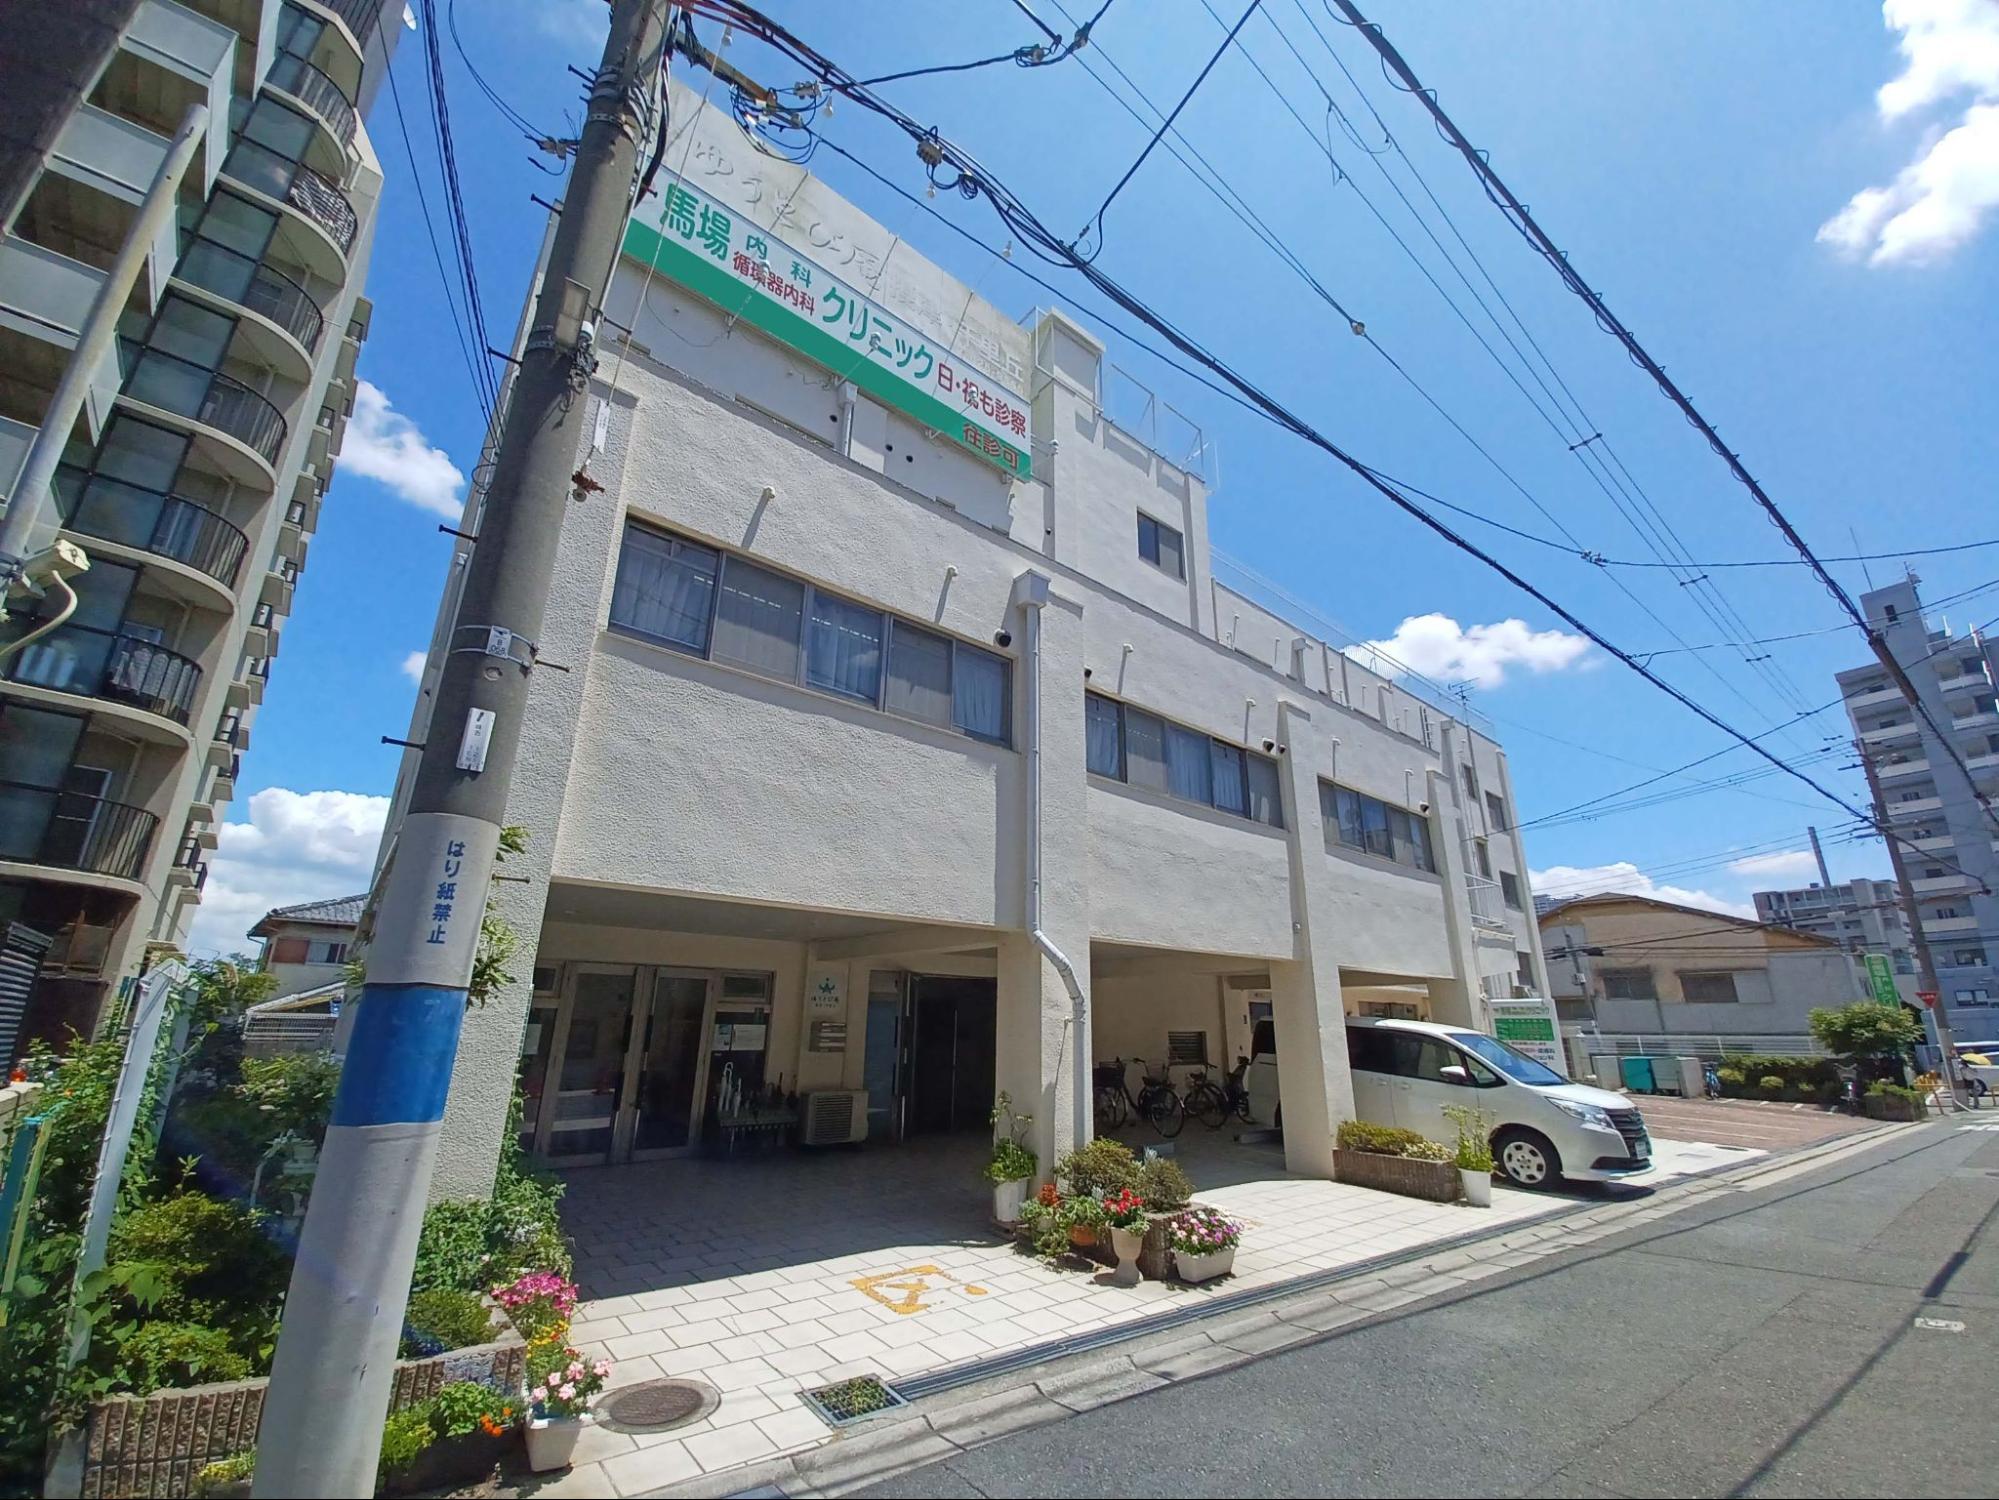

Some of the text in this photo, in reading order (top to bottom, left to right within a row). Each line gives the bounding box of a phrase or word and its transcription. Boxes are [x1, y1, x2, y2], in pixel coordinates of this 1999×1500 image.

[660, 183, 731, 261] 馬場
[733, 251, 816, 316] 循環器内科
[822, 286, 934, 379] クリニック
[963, 423, 1018, 470] 往診可
[426, 840, 466, 944] はり紙禁止
